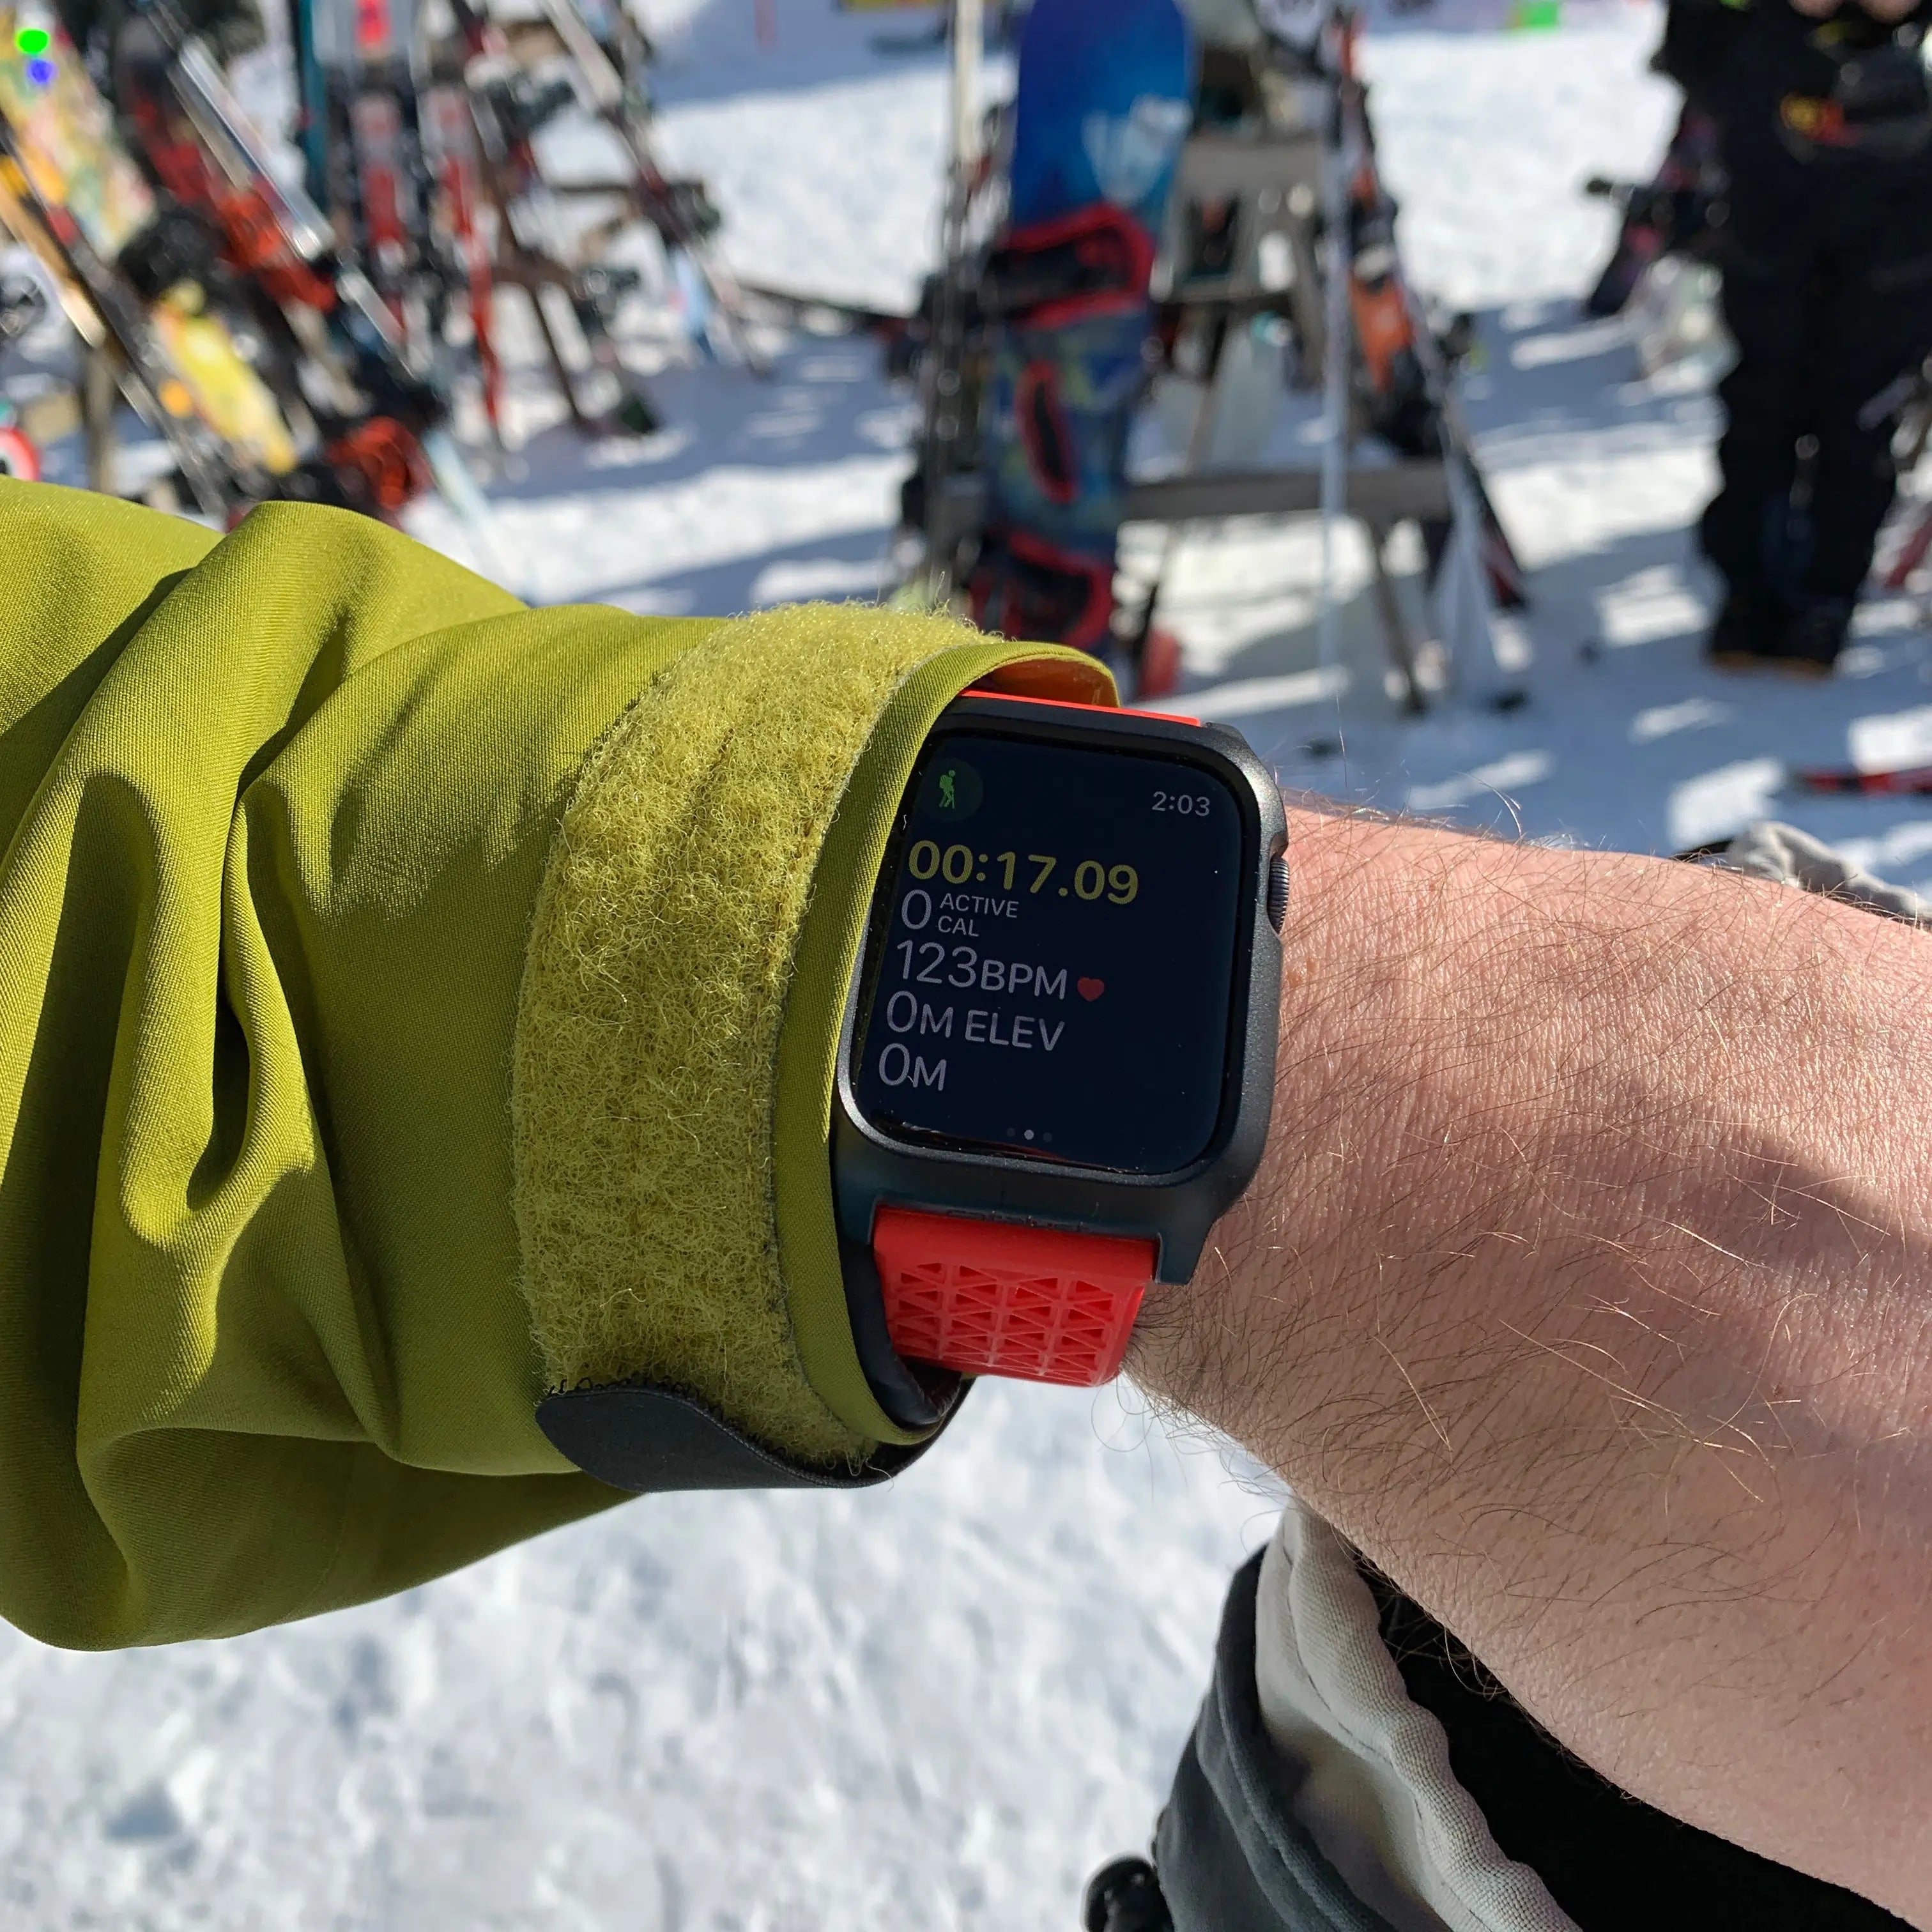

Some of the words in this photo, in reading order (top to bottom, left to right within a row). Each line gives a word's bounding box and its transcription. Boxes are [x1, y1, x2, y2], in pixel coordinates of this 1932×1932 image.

[1152, 791, 1211, 816] 2:03
[908, 839, 1139, 905] 00:17.09
[901, 889, 932, 930] 0
[939, 893, 1019, 919] ACTIVE
[937, 916, 979, 937] CAL
[896, 940, 1068, 1000] 123BPM
[886, 990, 954, 1038] 0M
[965, 1009, 1065, 1052] ELEV
[878, 1043, 947, 1091] 0M
